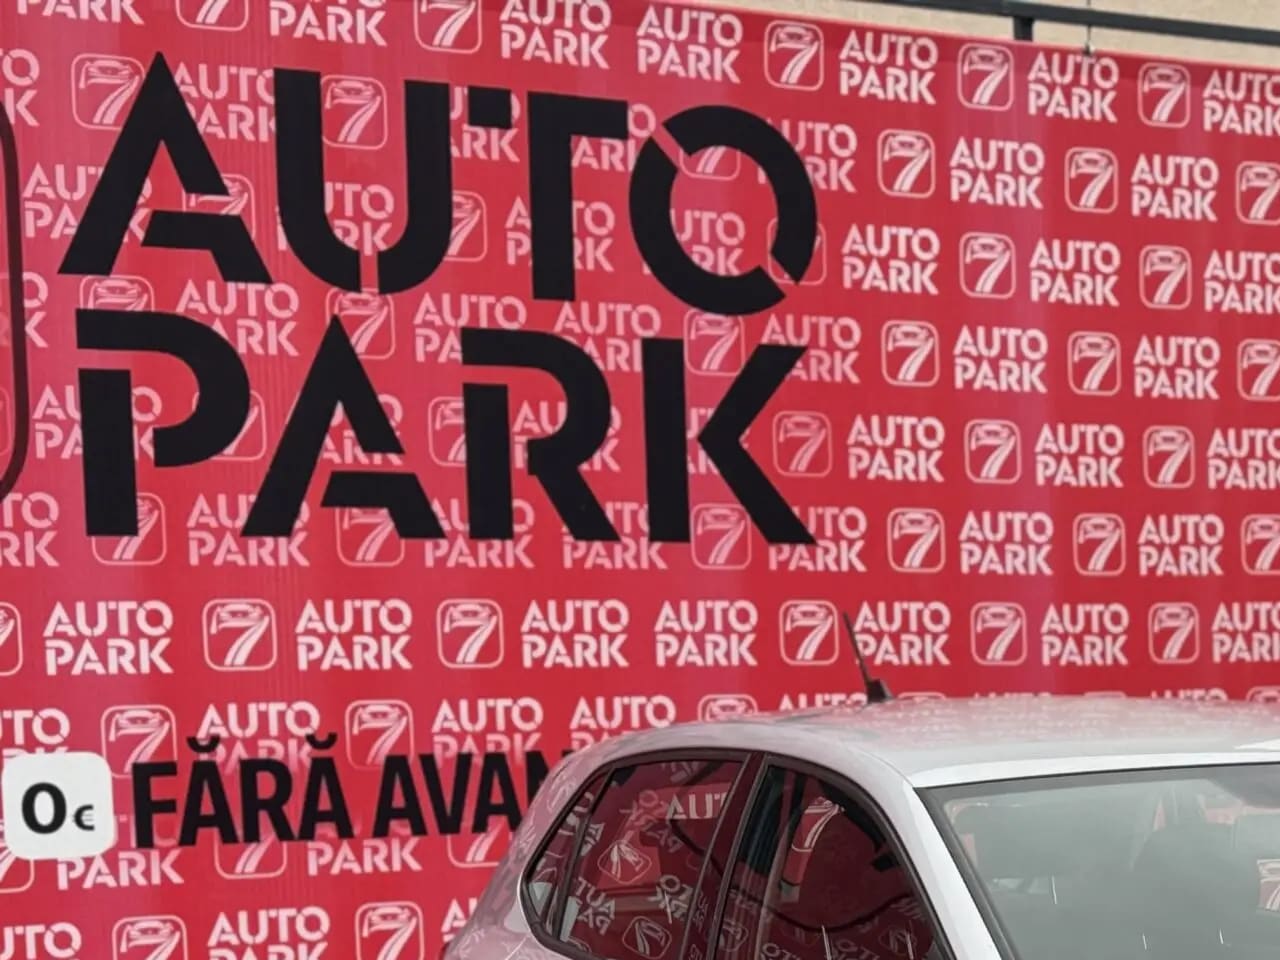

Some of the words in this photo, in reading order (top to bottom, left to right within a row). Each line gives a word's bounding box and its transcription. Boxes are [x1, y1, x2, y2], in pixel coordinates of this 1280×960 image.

[270, 0, 387, 46] PARK
[500, 0, 611, 32] AUTO
[636, 6, 742, 47] AUTO
[501, 24, 609, 69] PARK
[638, 38, 740, 83] PARK
[839, 34, 937, 69] AUTO
[840, 62, 936, 105] PARK
[1028, 54, 1118, 88] AUTO
[1028, 83, 1117, 123] PARK
[950, 136, 1045, 175] AUTO
[1132, 154, 1219, 188] AUTO
[57, 51, 819, 315] AUTO
[951, 169, 1043, 209] PARK
[1131, 185, 1217, 222] PARK
[842, 224, 940, 260] AUTO
[1030, 238, 1121, 273] AUTO
[843, 256, 939, 295] PARK
[1030, 270, 1119, 307] PARK
[175, 280, 299, 318] AUTO
[414, 293, 527, 330] AUTO
[553, 301, 661, 337] AUTO
[761, 314, 861, 349] AUTO
[954, 325, 1048, 360] AUTO
[1134, 335, 1220, 368] AUTO
[955, 357, 1047, 394] PARK
[1134, 367, 1219, 400] PARK
[75, 308, 817, 546] PARK
[848, 414, 945, 448] AUTO
[1035, 423, 1124, 455] AUTO
[849, 448, 944, 482] PARK
[1036, 455, 1123, 488] PARK
[960, 511, 1053, 543] AUTO
[1139, 514, 1224, 544] AUTO
[189, 531, 309, 566] PARK
[425, 535, 534, 568] PARK
[563, 535, 667, 569] PARK
[769, 539, 867, 572] PARK
[960, 543, 1053, 576] PARK
[1139, 546, 1223, 576] PARK
[43, 600, 173, 637] AUTO
[295, 598, 413, 633] AUTO
[521, 599, 629, 632] AUTO
[654, 600, 758, 634] AUTO
[853, 601, 951, 632] AUTO
[1041, 603, 1129, 633] AUTO
[45, 637, 173, 676] PARK
[297, 635, 413, 671] PARK
[522, 634, 629, 668] PARK
[656, 633, 758, 667] PARK
[855, 634, 950, 666] PARK
[1042, 635, 1128, 666] PARK
[196, 701, 320, 745] AUTO
[432, 697, 544, 733] AUTO
[570, 695, 675, 730] AUTO
[131, 731, 355, 849] FĂRĂ
[58, 848, 184, 890] PARK
[307, 837, 422, 876] PARK
[208, 906, 330, 947] AUTO
